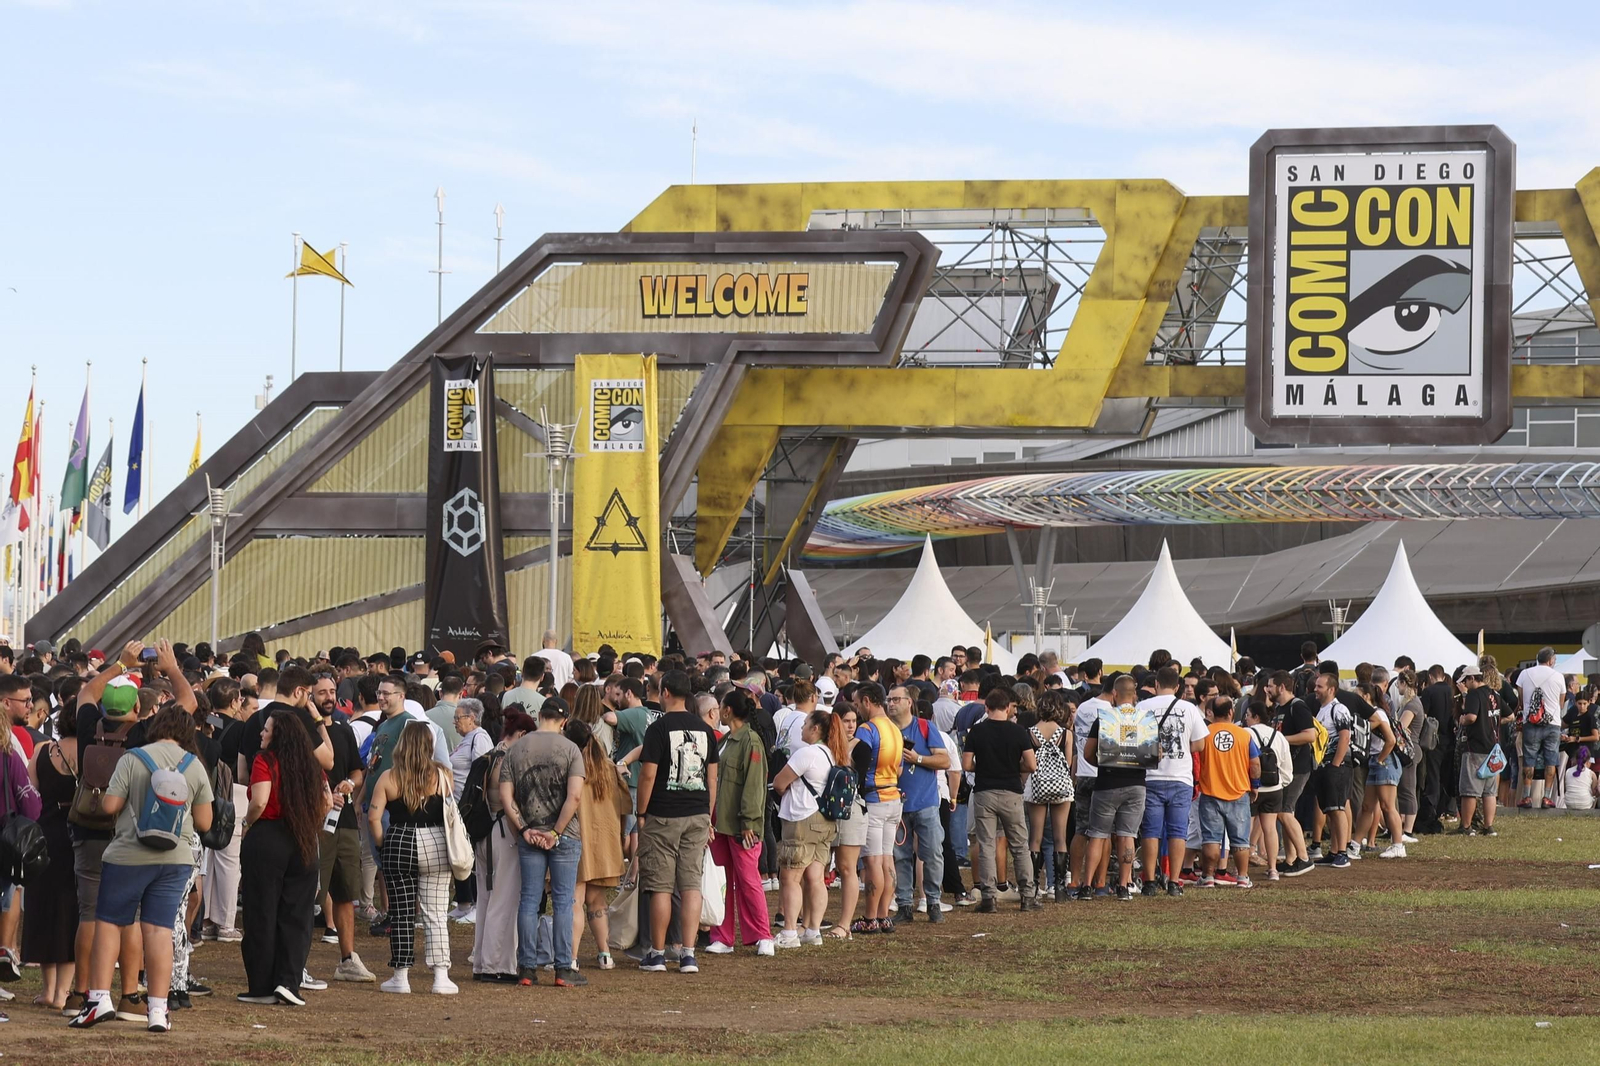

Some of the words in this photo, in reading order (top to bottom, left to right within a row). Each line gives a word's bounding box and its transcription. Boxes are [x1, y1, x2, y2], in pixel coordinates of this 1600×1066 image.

[1287, 164, 1345, 182] SAN
[1374, 162, 1475, 181] DIEGO
[1354, 187, 1472, 247] CON
[639, 272, 809, 319] WELCOME
[1288, 189, 1349, 373] COMIC
[447, 388, 464, 440] COMIC
[594, 388, 611, 440] COMIC
[611, 388, 642, 406] CON
[1216, 732, 1233, 750] 悟
